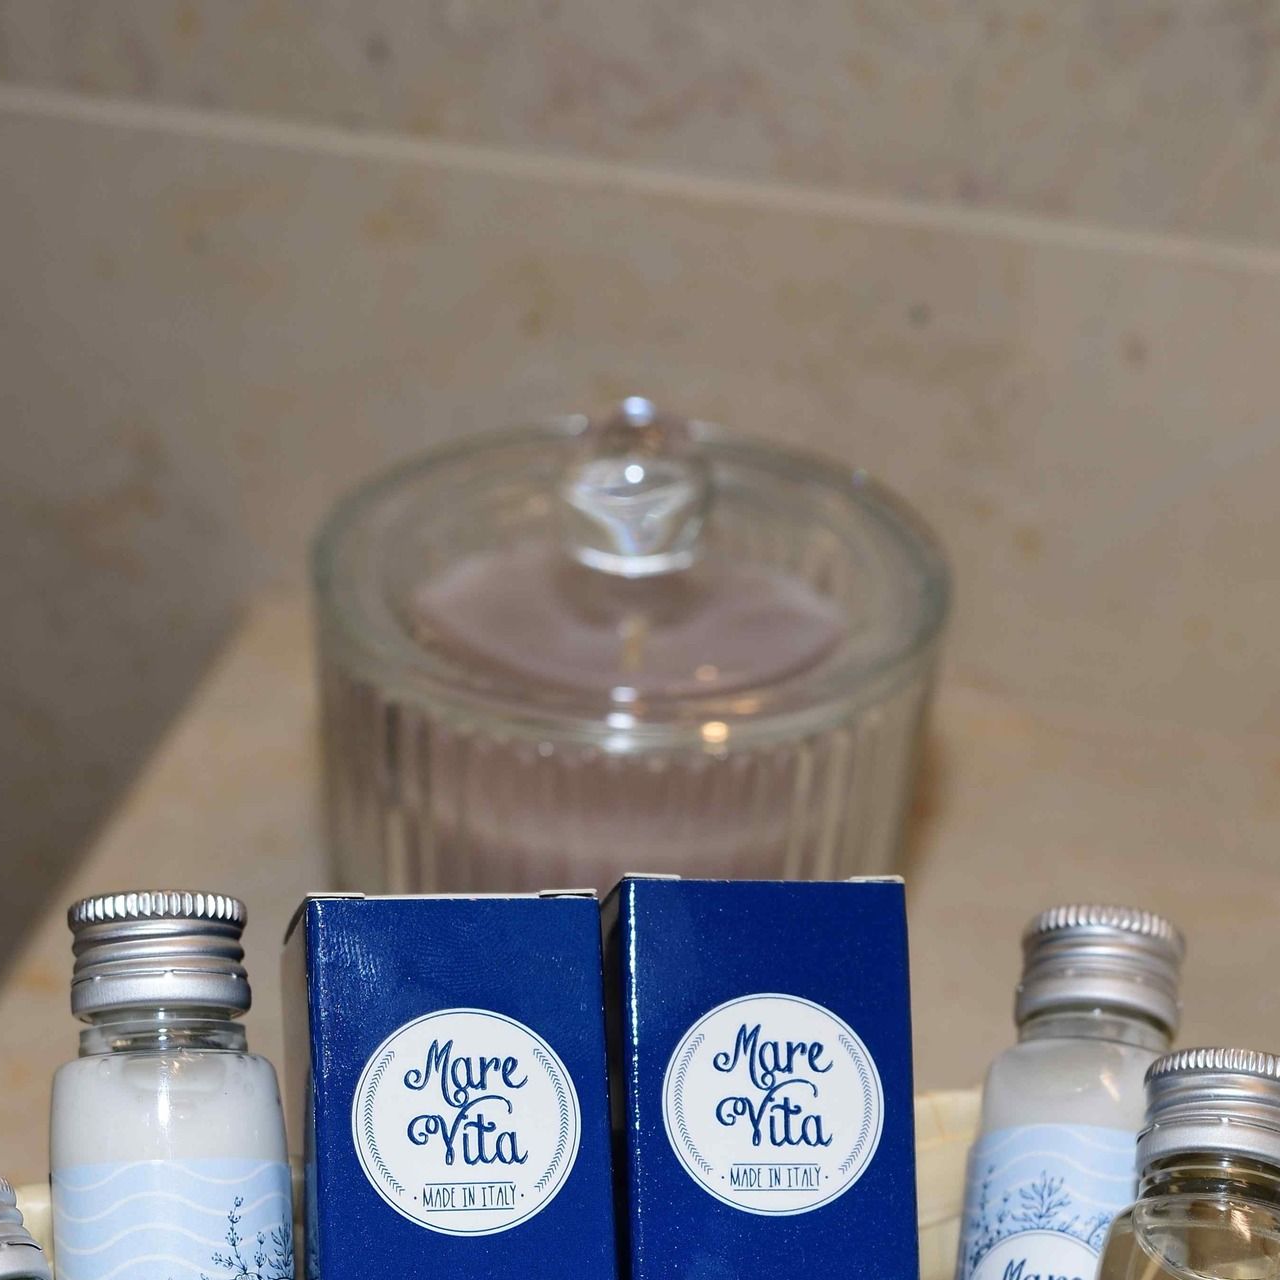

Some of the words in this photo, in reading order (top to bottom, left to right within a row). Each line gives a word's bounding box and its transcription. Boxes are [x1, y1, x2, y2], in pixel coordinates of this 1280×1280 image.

[403, 1039, 529, 1109] Mare
[713, 1023, 834, 1091] Mare
[406, 1094, 529, 1166] Vita
[715, 1078, 834, 1147] Vita
[422, 1186, 456, 1209] MADE
[461, 1186, 476, 1208] IN
[481, 1184, 517, 1208] ITALY
[730, 1167, 763, 1188] MADE
[768, 1167, 781, 1188] IN
[787, 1166, 822, 1188] ITALY
